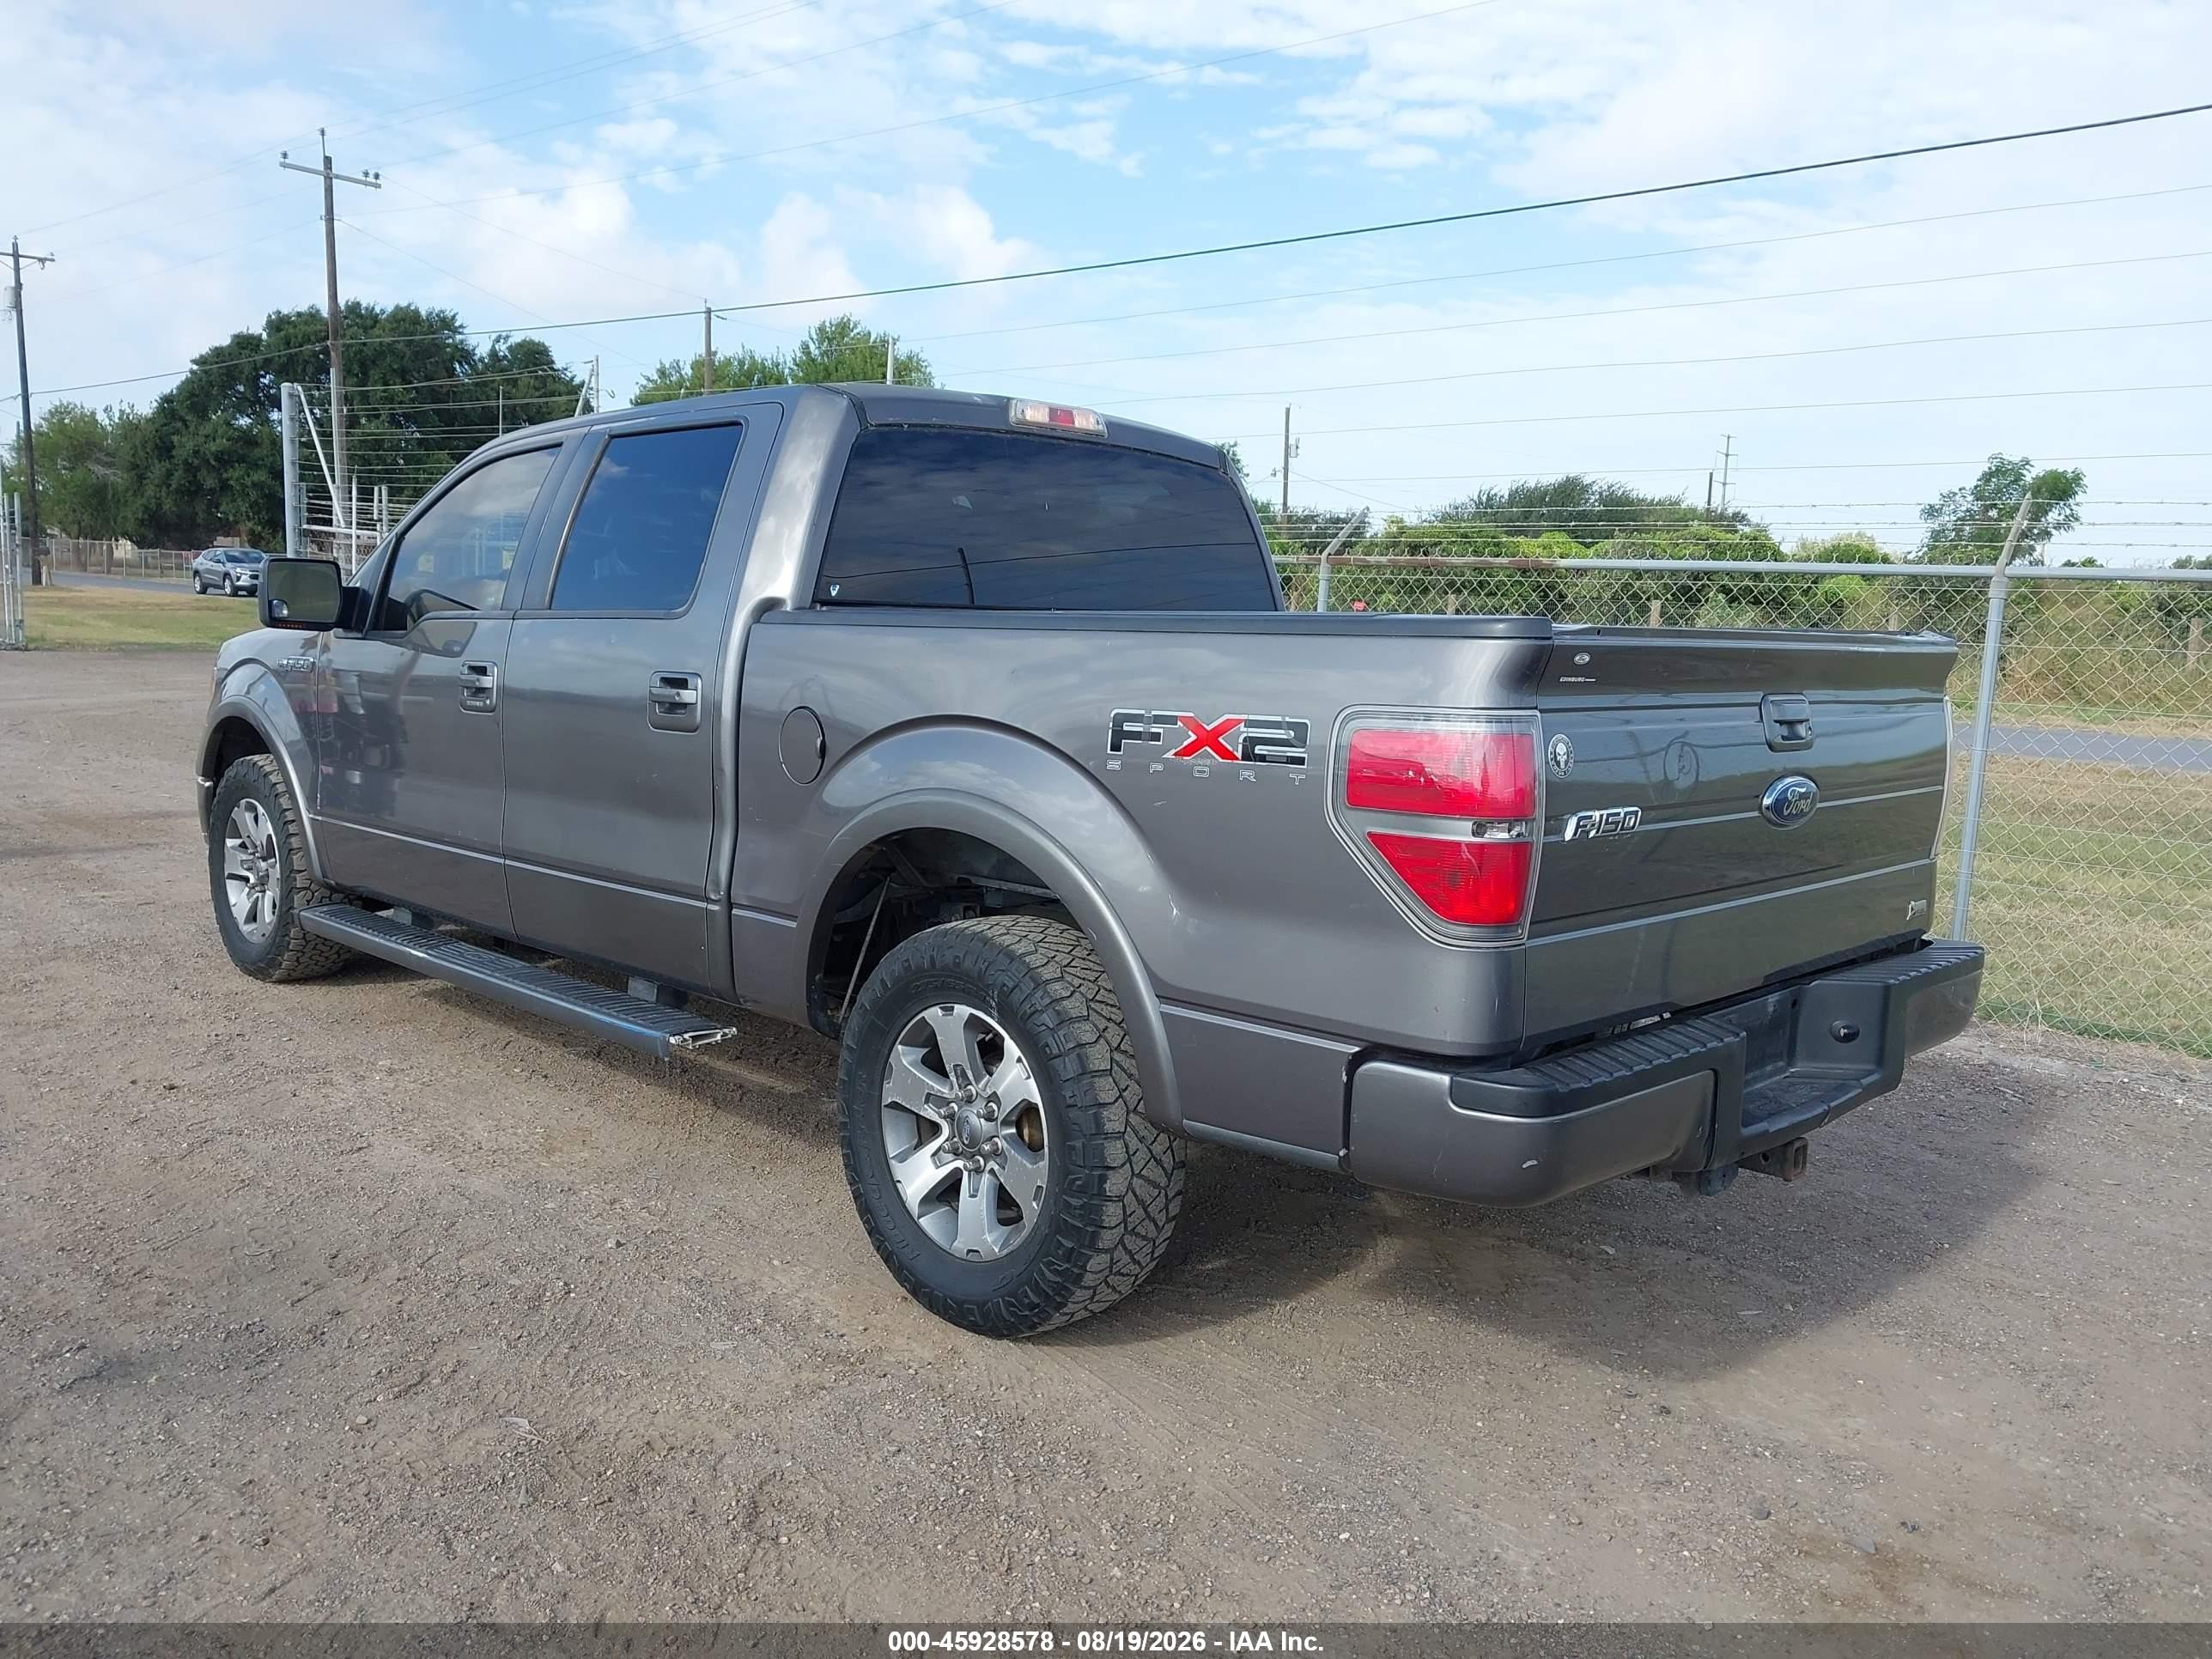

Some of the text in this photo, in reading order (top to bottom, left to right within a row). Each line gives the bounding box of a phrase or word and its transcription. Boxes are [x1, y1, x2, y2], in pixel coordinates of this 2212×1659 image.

[1107, 708, 1311, 769] FX2
[1106, 758, 1306, 785] SPORT
[1784, 787, 1813, 816] Ford
